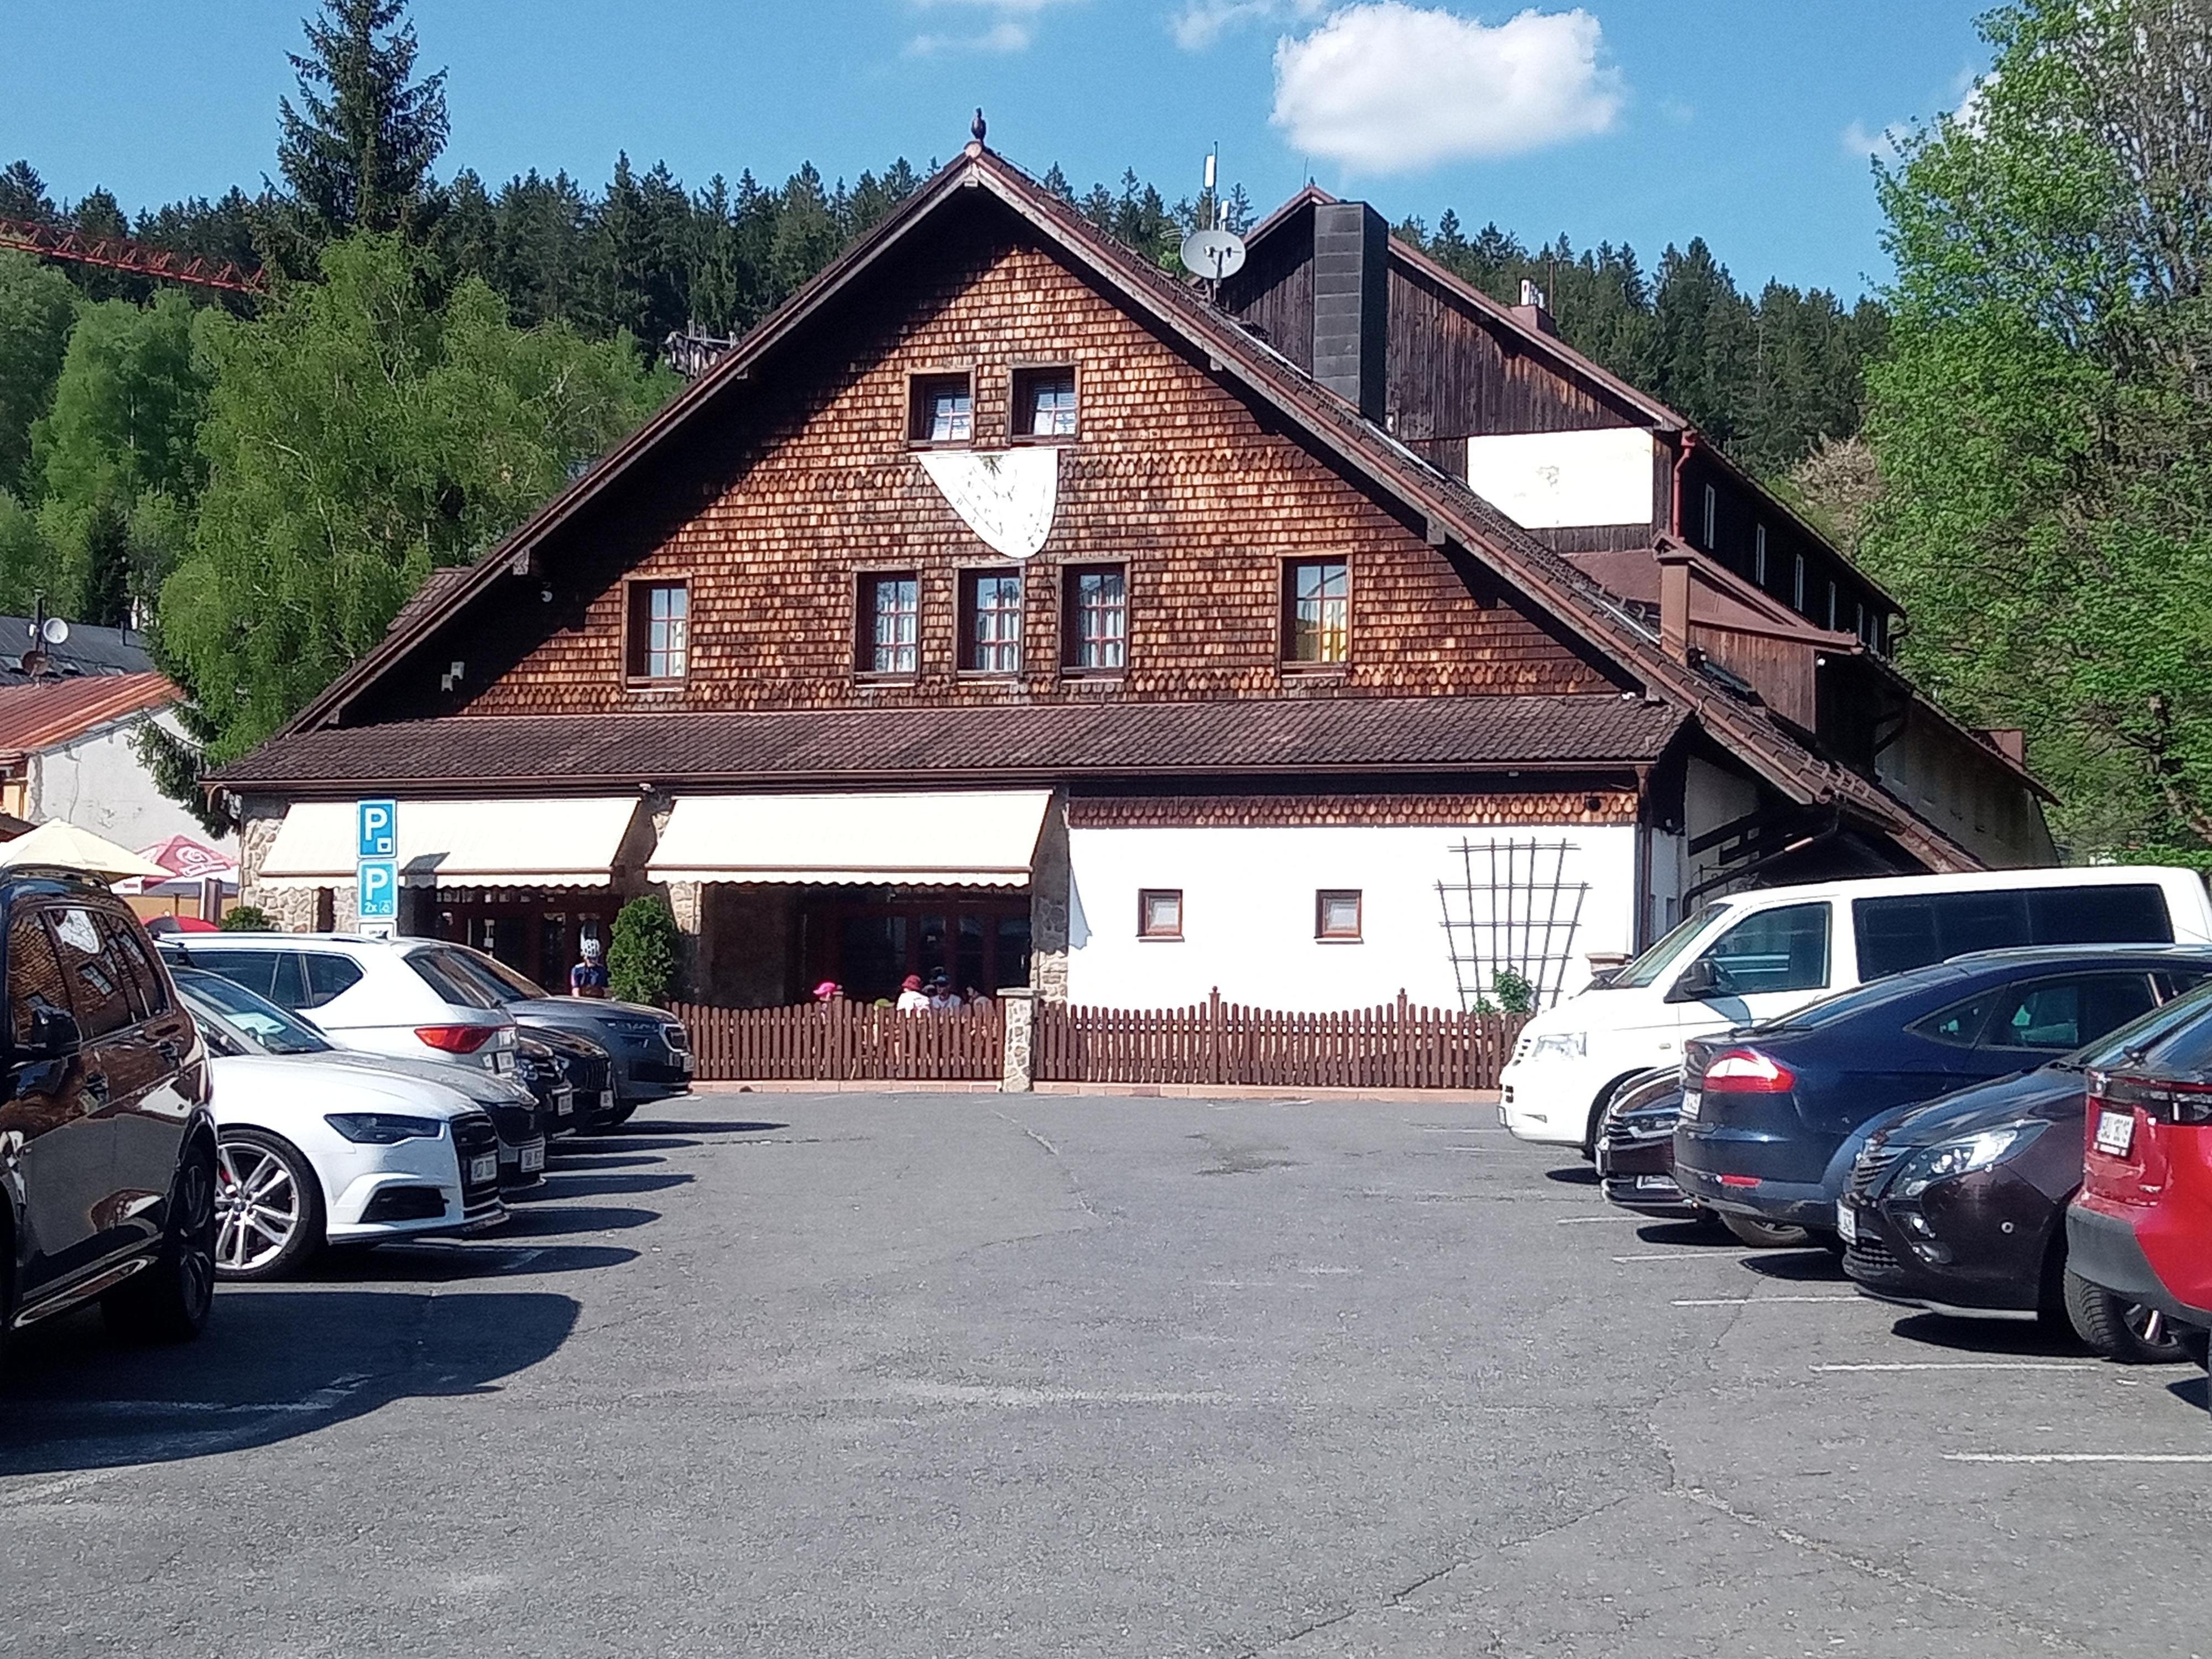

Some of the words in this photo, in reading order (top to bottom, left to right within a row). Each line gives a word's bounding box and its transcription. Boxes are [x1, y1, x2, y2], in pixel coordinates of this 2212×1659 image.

[364, 807, 388, 841] P
[366, 868, 388, 900] P
[364, 901, 378, 913] 2x
